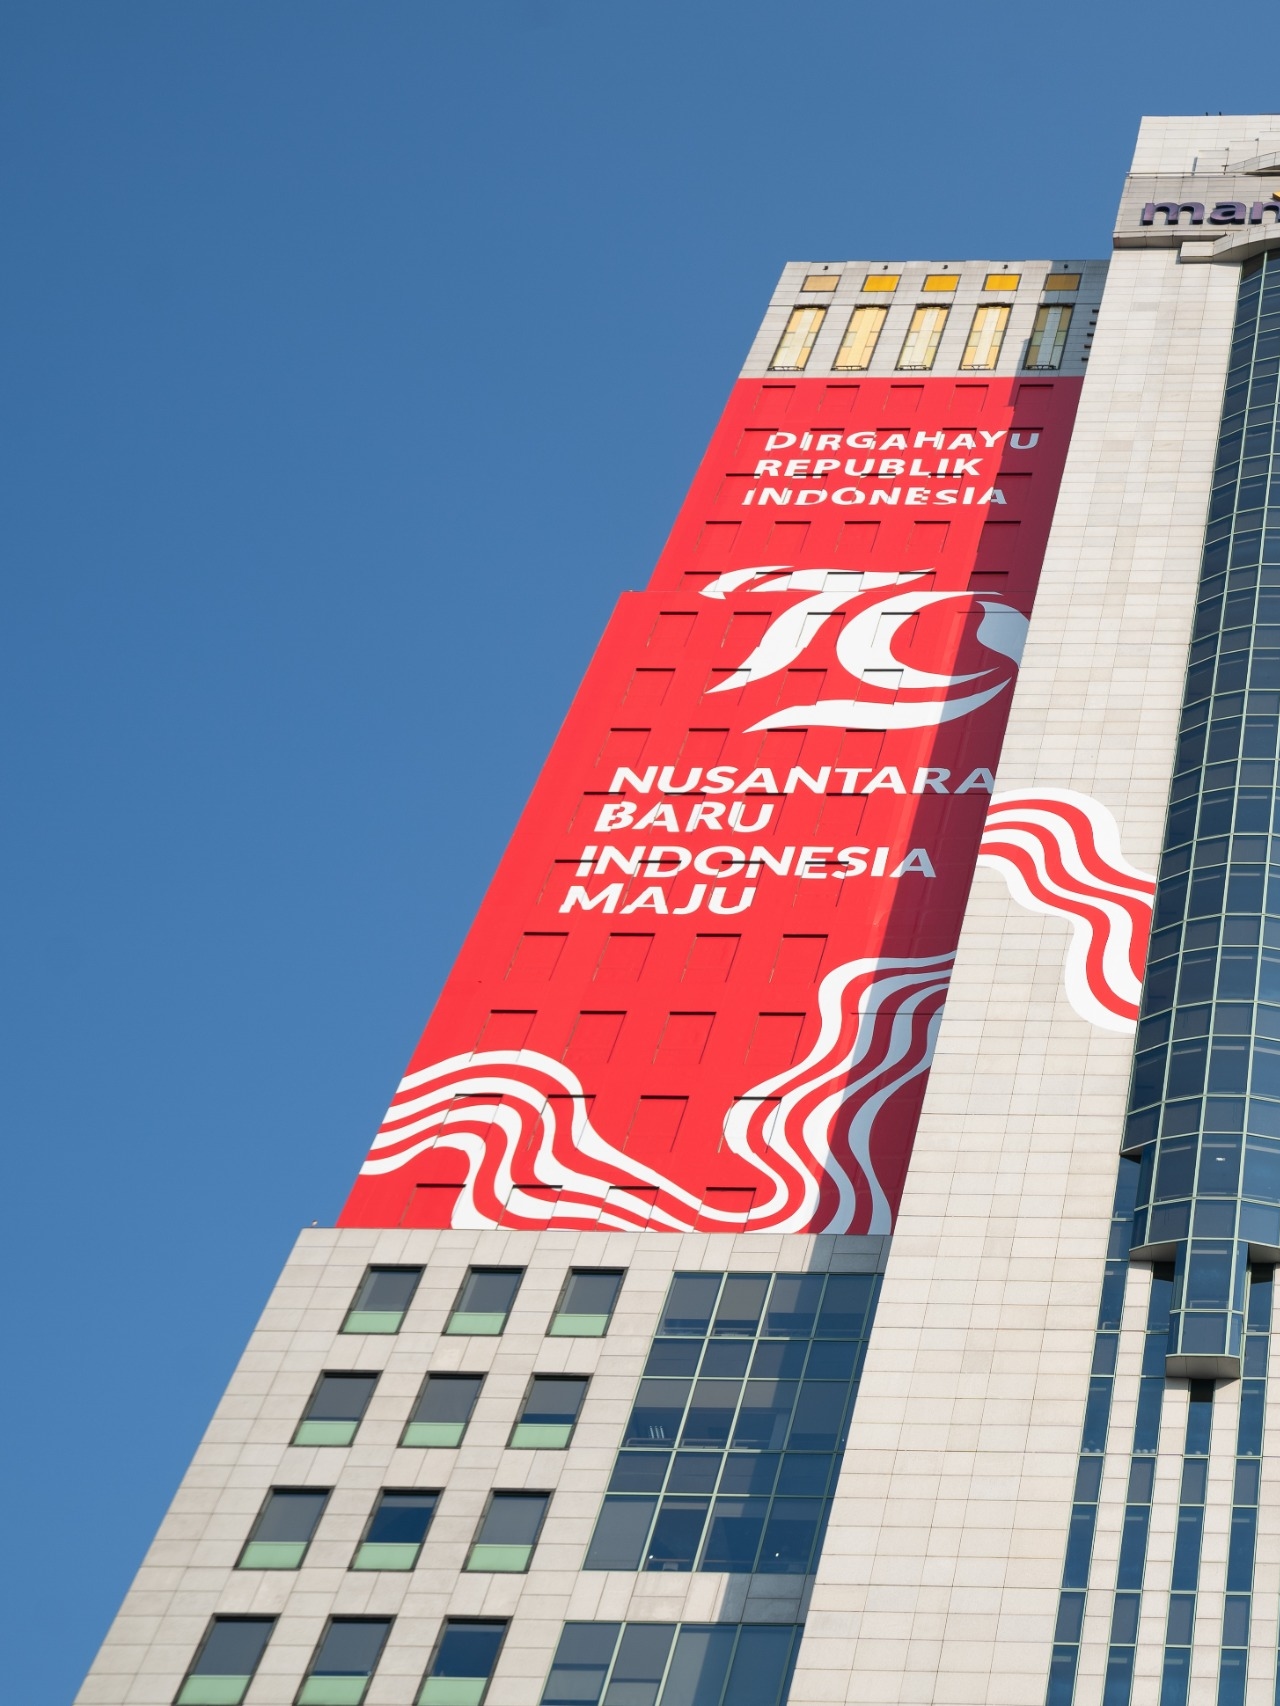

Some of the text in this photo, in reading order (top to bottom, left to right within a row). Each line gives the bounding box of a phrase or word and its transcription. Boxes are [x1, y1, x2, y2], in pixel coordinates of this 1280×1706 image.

[765, 430, 1040, 452] DIRGAHAYU
[753, 458, 984, 480] REPUBLIK
[741, 486, 1008, 507] INDONESIA
[608, 765, 996, 795] NUSANTARA
[594, 800, 775, 833] BARU
[575, 845, 937, 879] INDONESIA
[558, 883, 757, 915] MAJU
